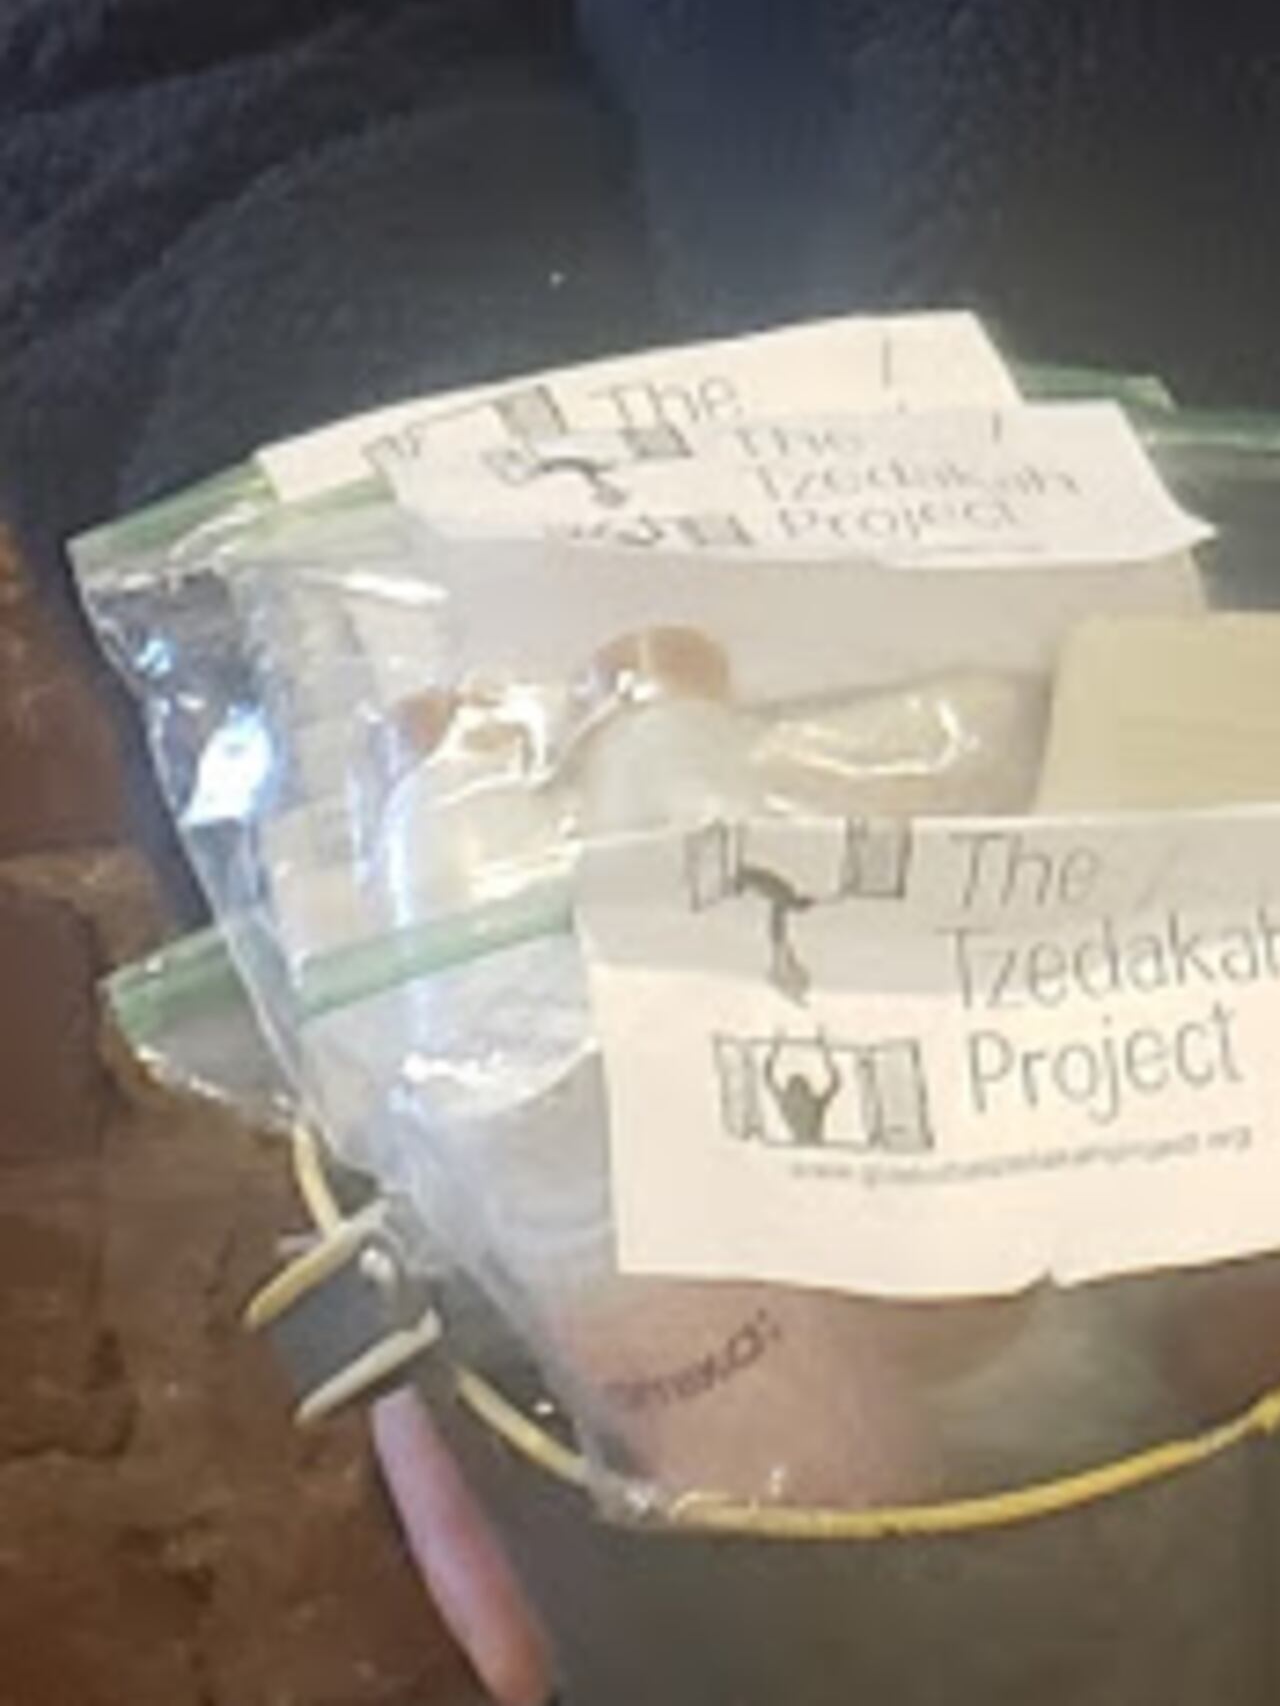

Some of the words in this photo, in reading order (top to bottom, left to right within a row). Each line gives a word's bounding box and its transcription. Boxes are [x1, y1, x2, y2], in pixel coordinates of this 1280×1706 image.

[733, 424, 866, 460] The
[776, 500, 1024, 543] Project
[945, 830, 1102, 910] The
[966, 997, 1245, 1127] Project
